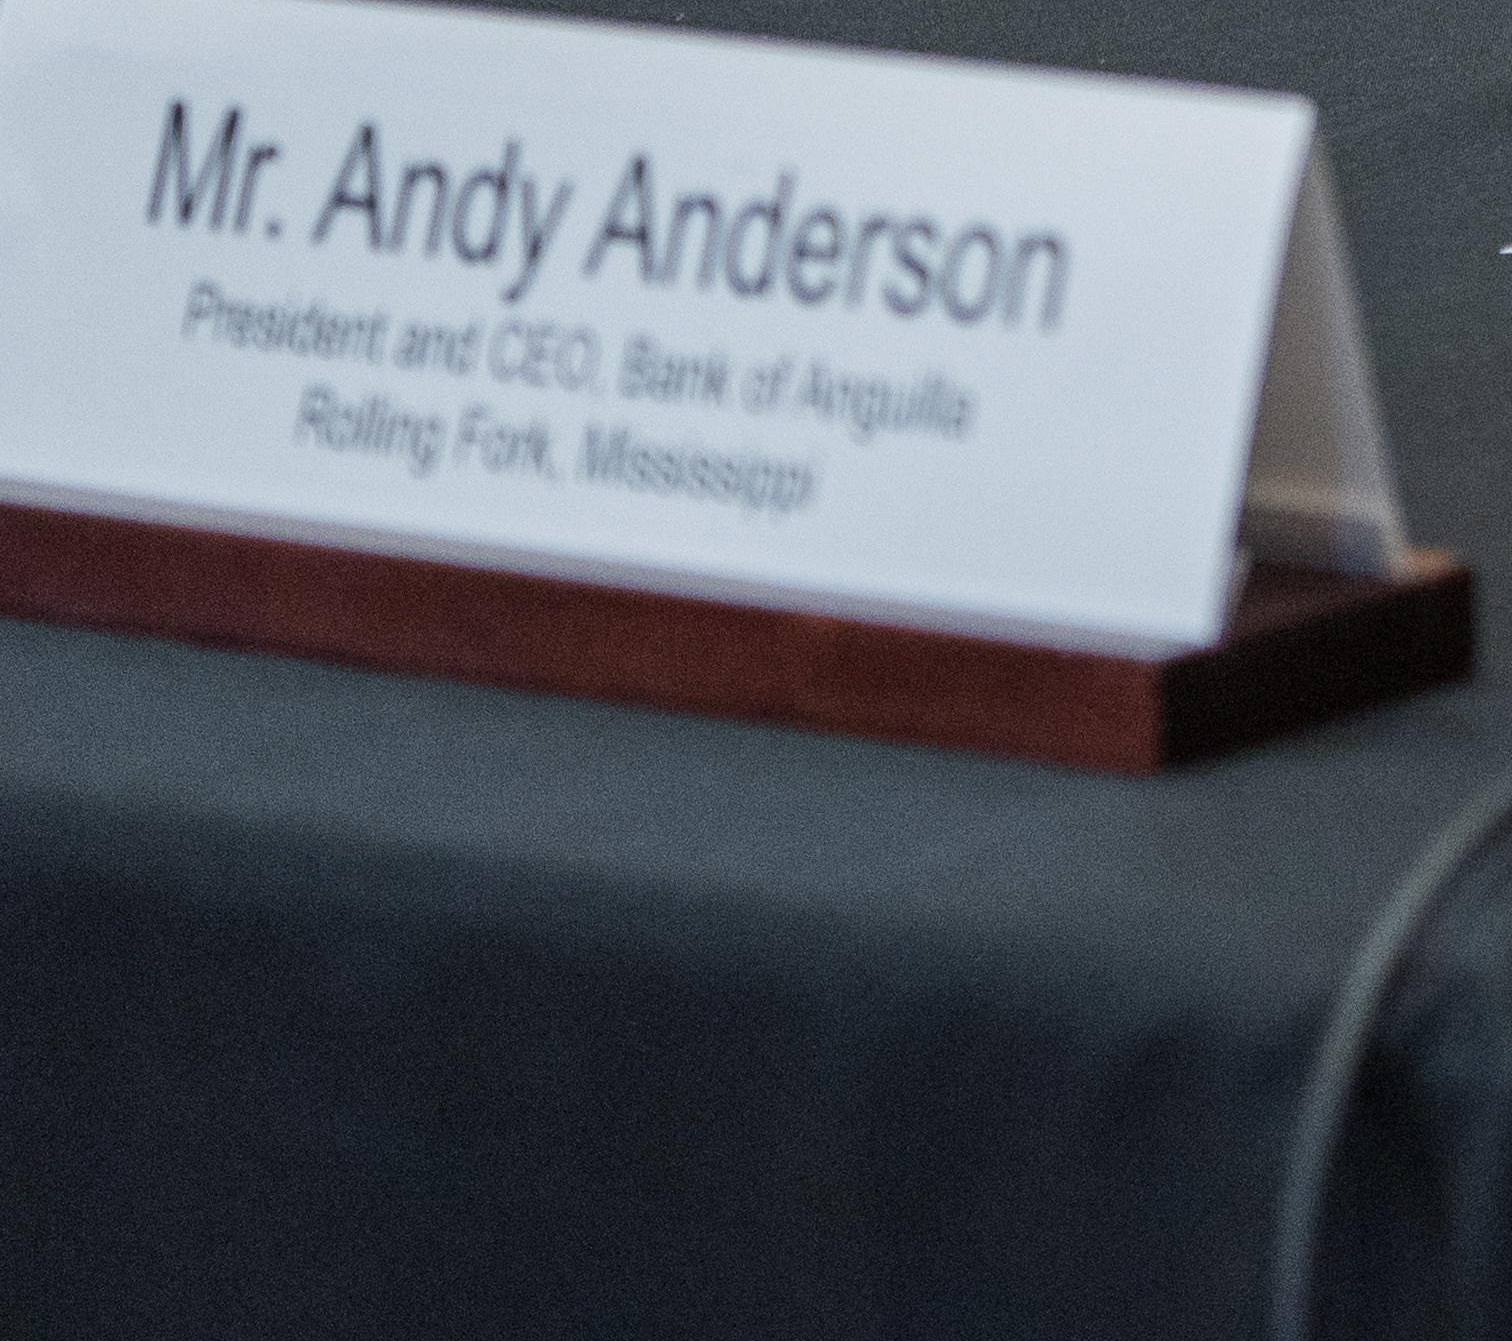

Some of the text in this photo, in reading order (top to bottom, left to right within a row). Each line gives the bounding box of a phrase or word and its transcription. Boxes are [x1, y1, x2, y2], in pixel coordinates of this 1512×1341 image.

[145, 100, 1071, 334] Mr. Andy Anderson
[180, 280, 978, 446] President and CEO, Bank of Anguilla
[295, 384, 822, 522] Rolling Fork, Mississippi
